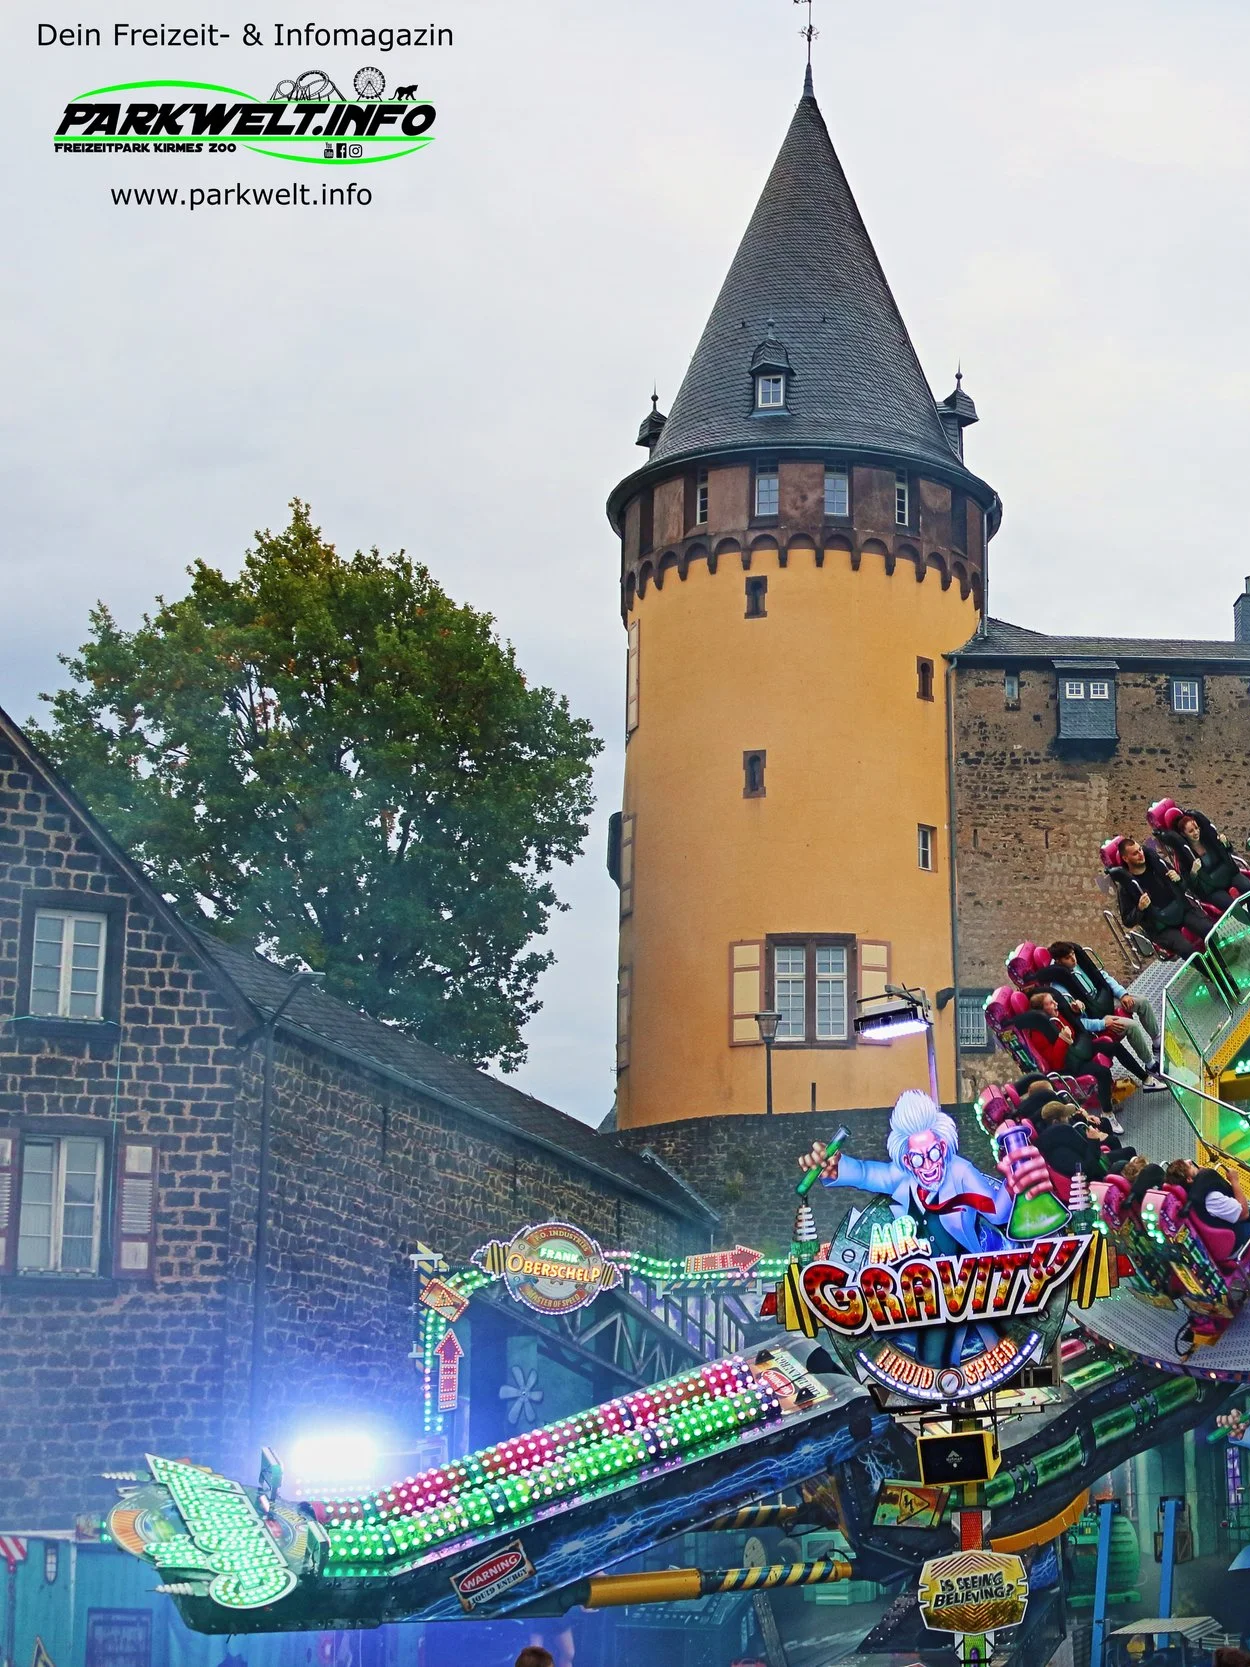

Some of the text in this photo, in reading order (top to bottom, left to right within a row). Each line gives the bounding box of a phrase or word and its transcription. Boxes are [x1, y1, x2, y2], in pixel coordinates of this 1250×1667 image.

[550, 1230, 592, 1255] INDUSTRIES
[869, 1215, 932, 1264] MR.
[507, 1253, 600, 1282] OBERSCHELP
[539, 1247, 580, 1263] FRANK
[801, 1235, 1092, 1333] GRAVITY
[526, 1288, 552, 1308] MASTER
[561, 1292, 581, 1307] SPEED
[875, 1338, 1018, 1390] LIQUID SPEED
[463, 1554, 519, 1590] WARNING
[496, 1568, 529, 1590] ENERGY
[940, 1571, 1004, 1592] IS SEEING
[933, 1583, 1015, 1608] BELIEVING?
